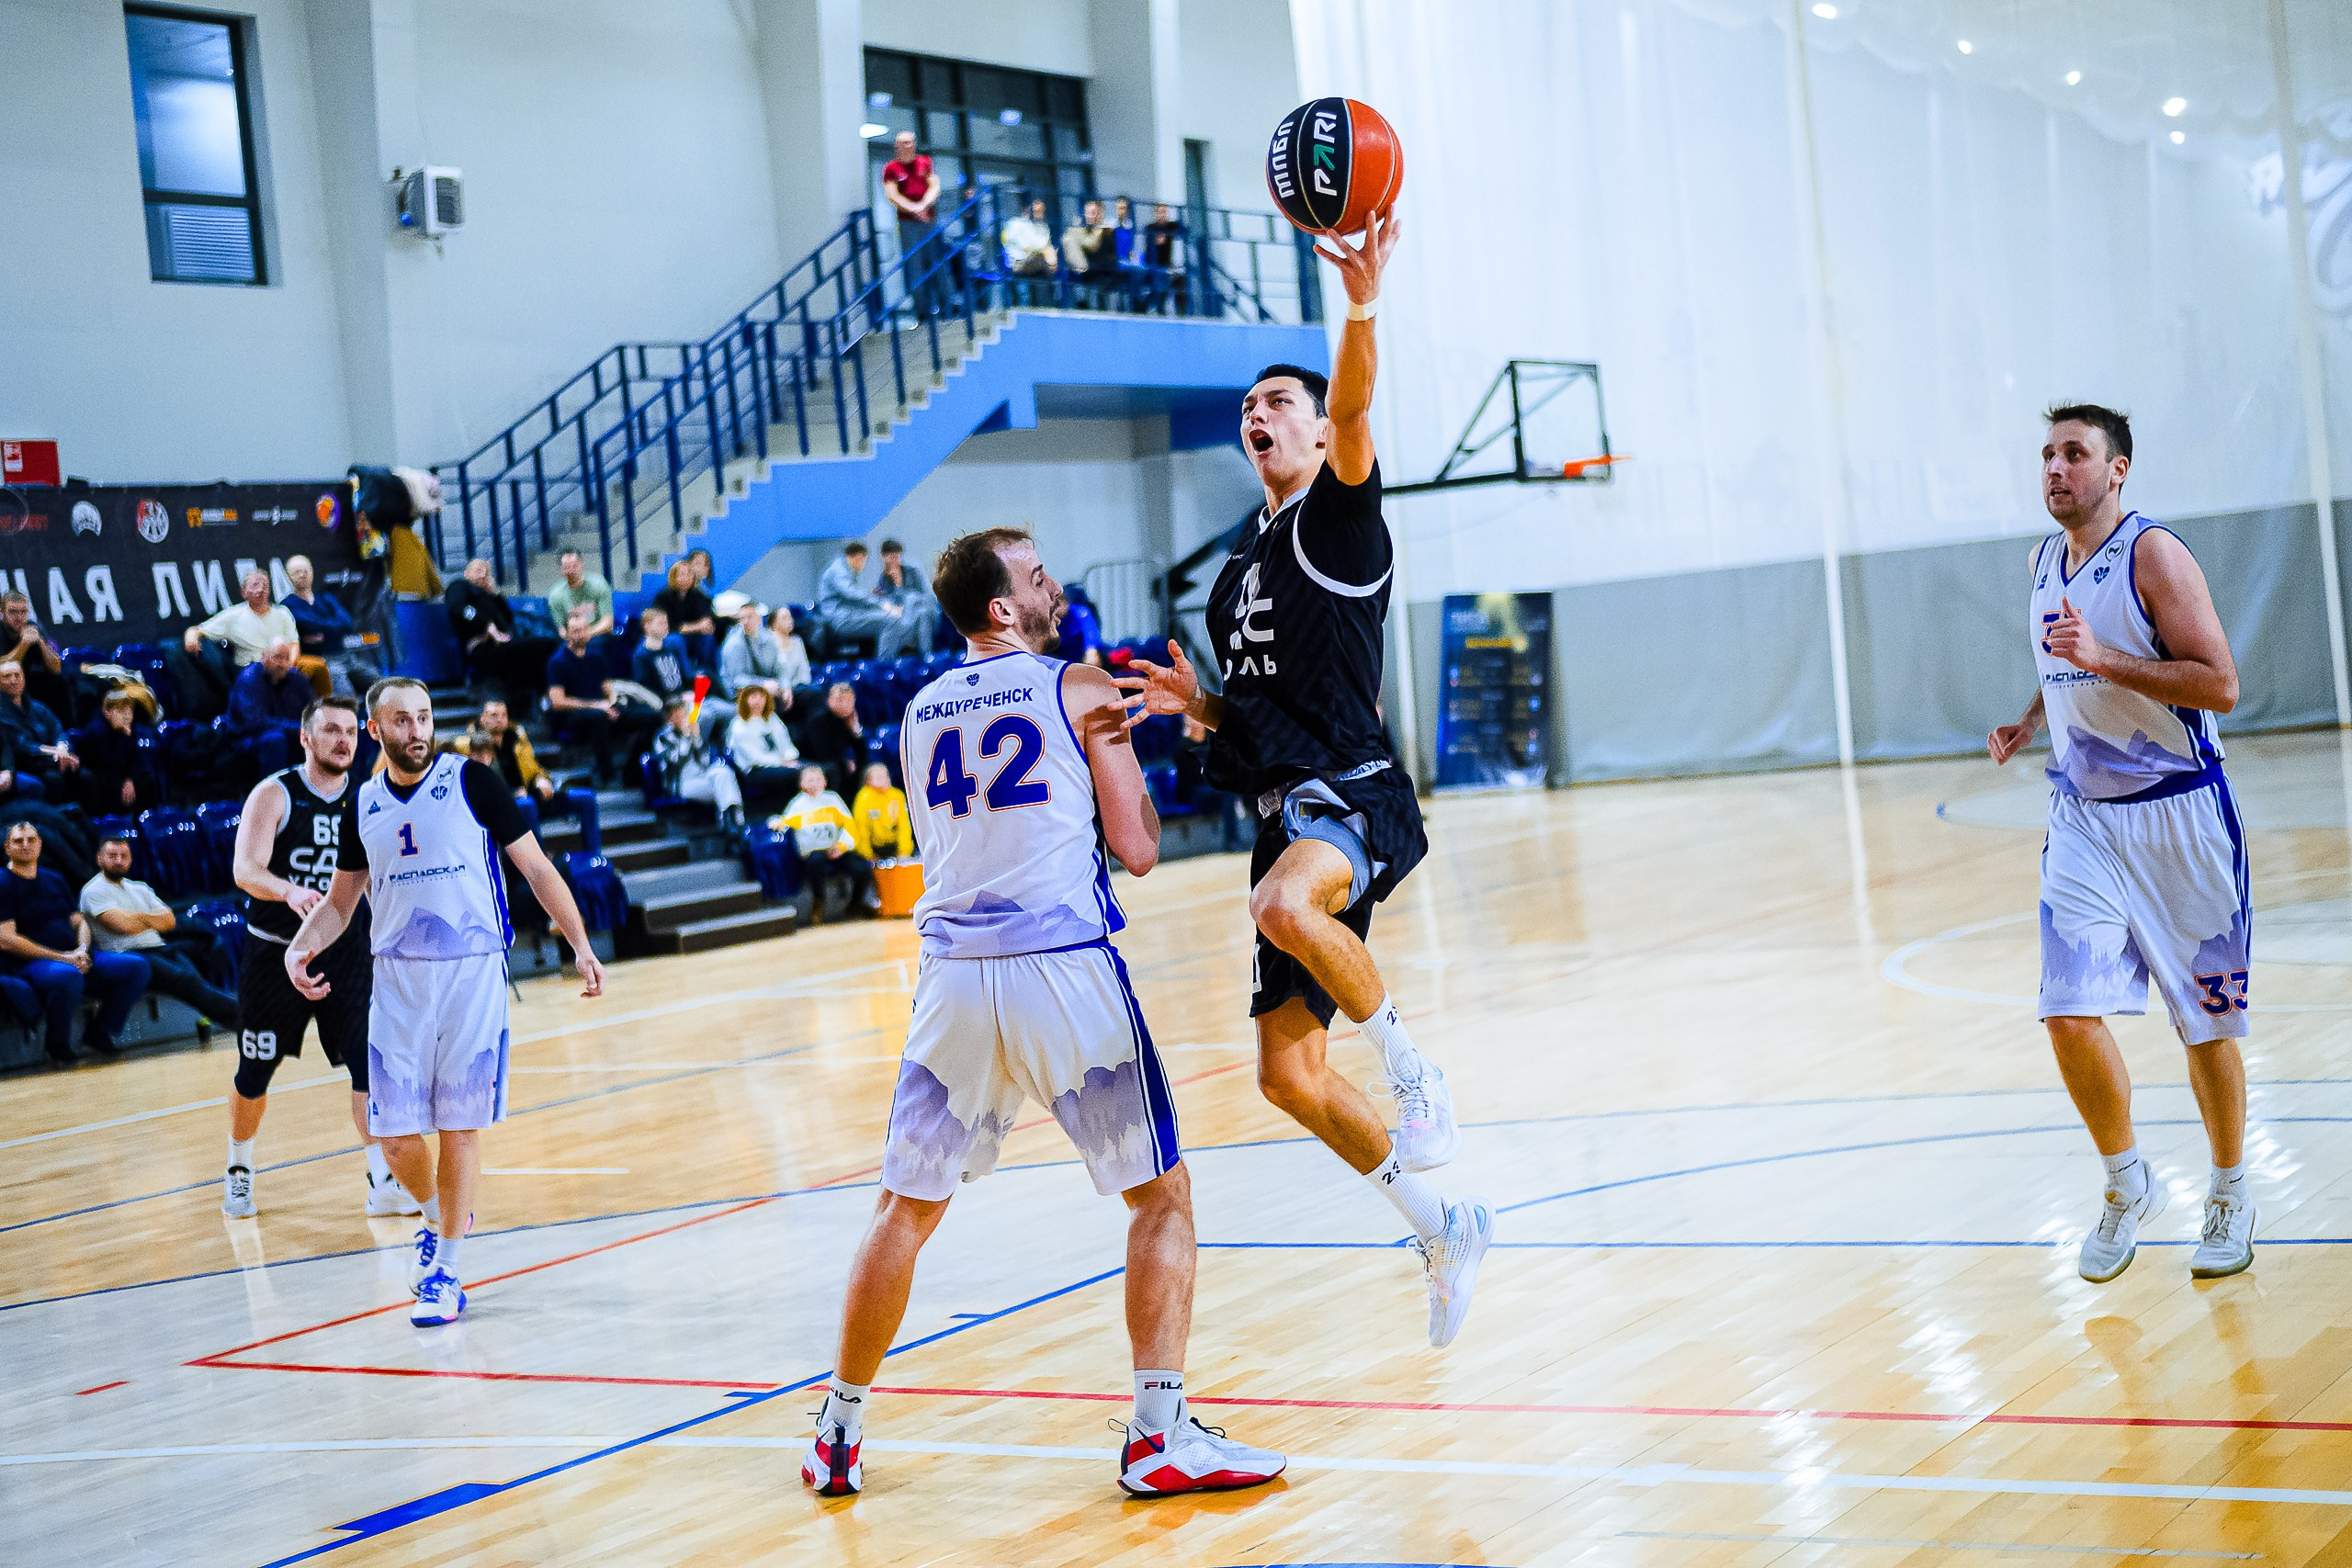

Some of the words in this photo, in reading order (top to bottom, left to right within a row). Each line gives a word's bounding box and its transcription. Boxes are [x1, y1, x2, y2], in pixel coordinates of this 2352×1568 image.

[1313, 111, 1338, 197] PARI
[916, 687, 1034, 724] МЕЖДУРЕЧЕНСК
[924, 714, 1051, 819] 42
[397, 820, 420, 858] 1
[242, 1028, 277, 1060] 69
